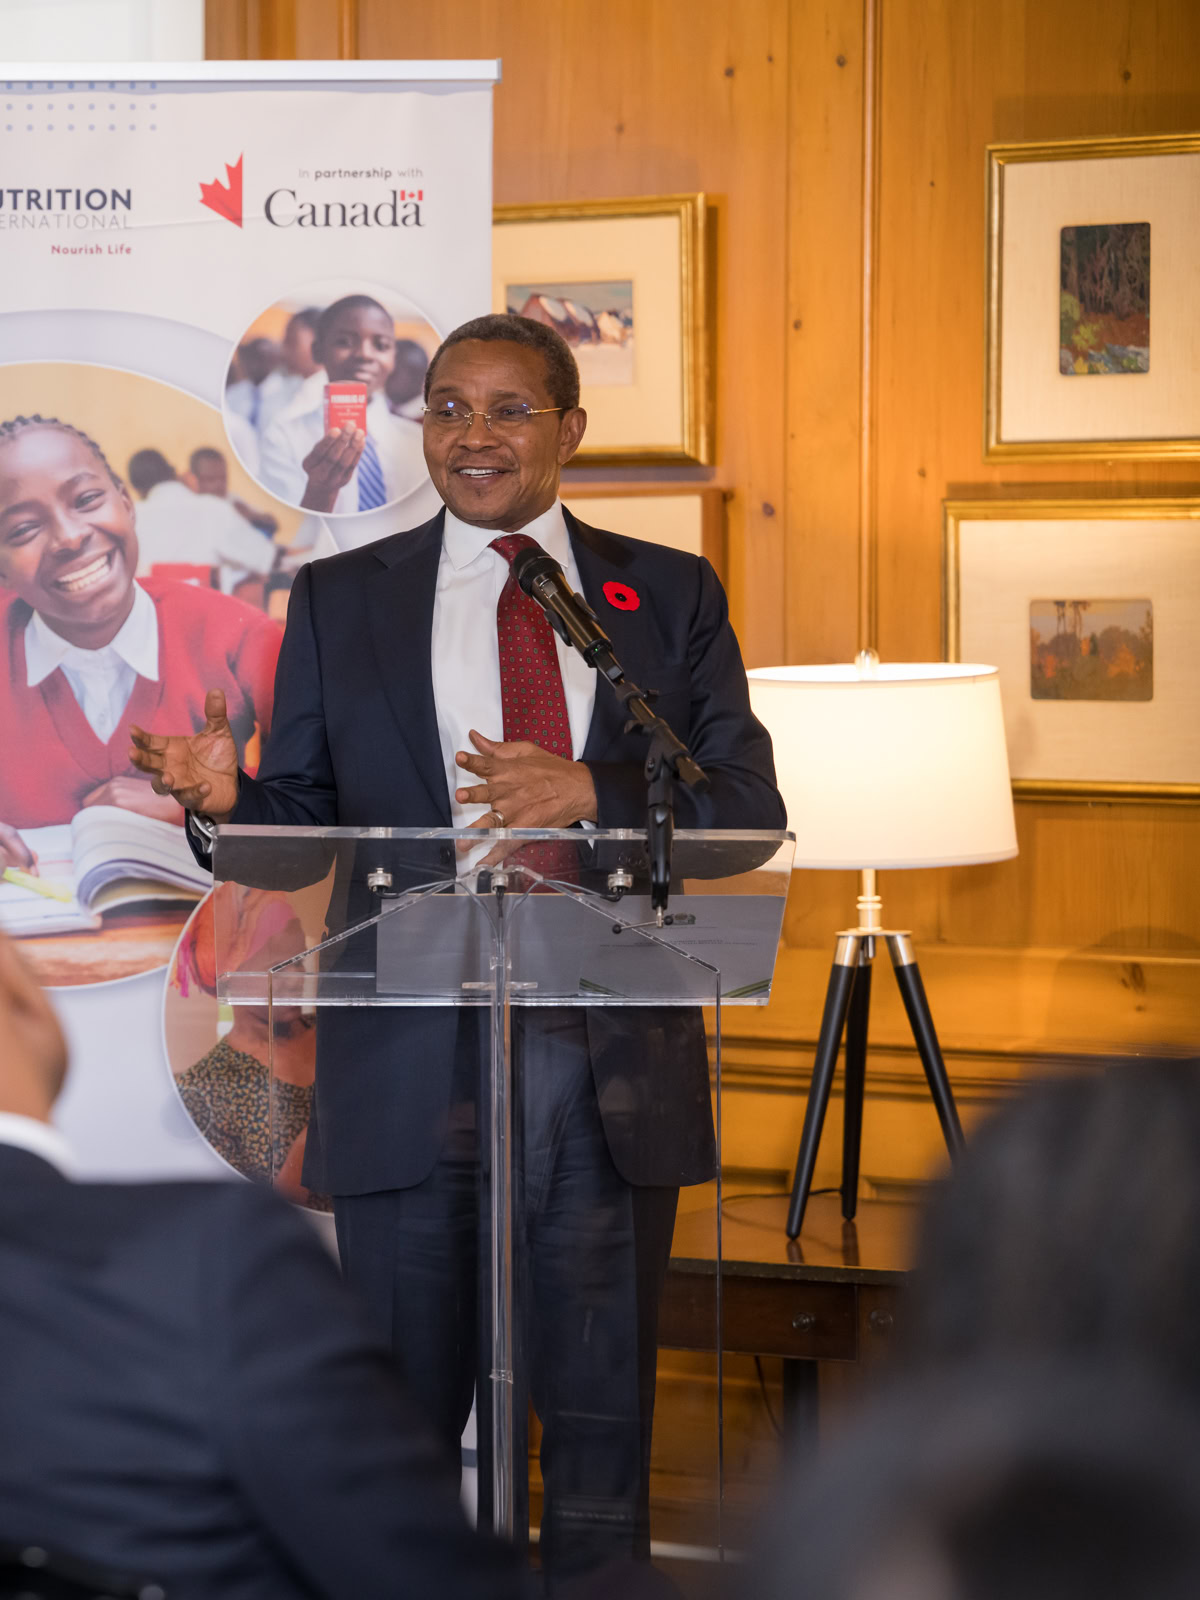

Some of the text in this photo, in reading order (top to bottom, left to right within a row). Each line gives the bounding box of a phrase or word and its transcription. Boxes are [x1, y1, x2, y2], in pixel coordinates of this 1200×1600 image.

[314, 168, 393, 181] partnership
[398, 168, 424, 179] with
[264, 189, 425, 228] Canada
[51, 244, 132, 255] Nourish Life
